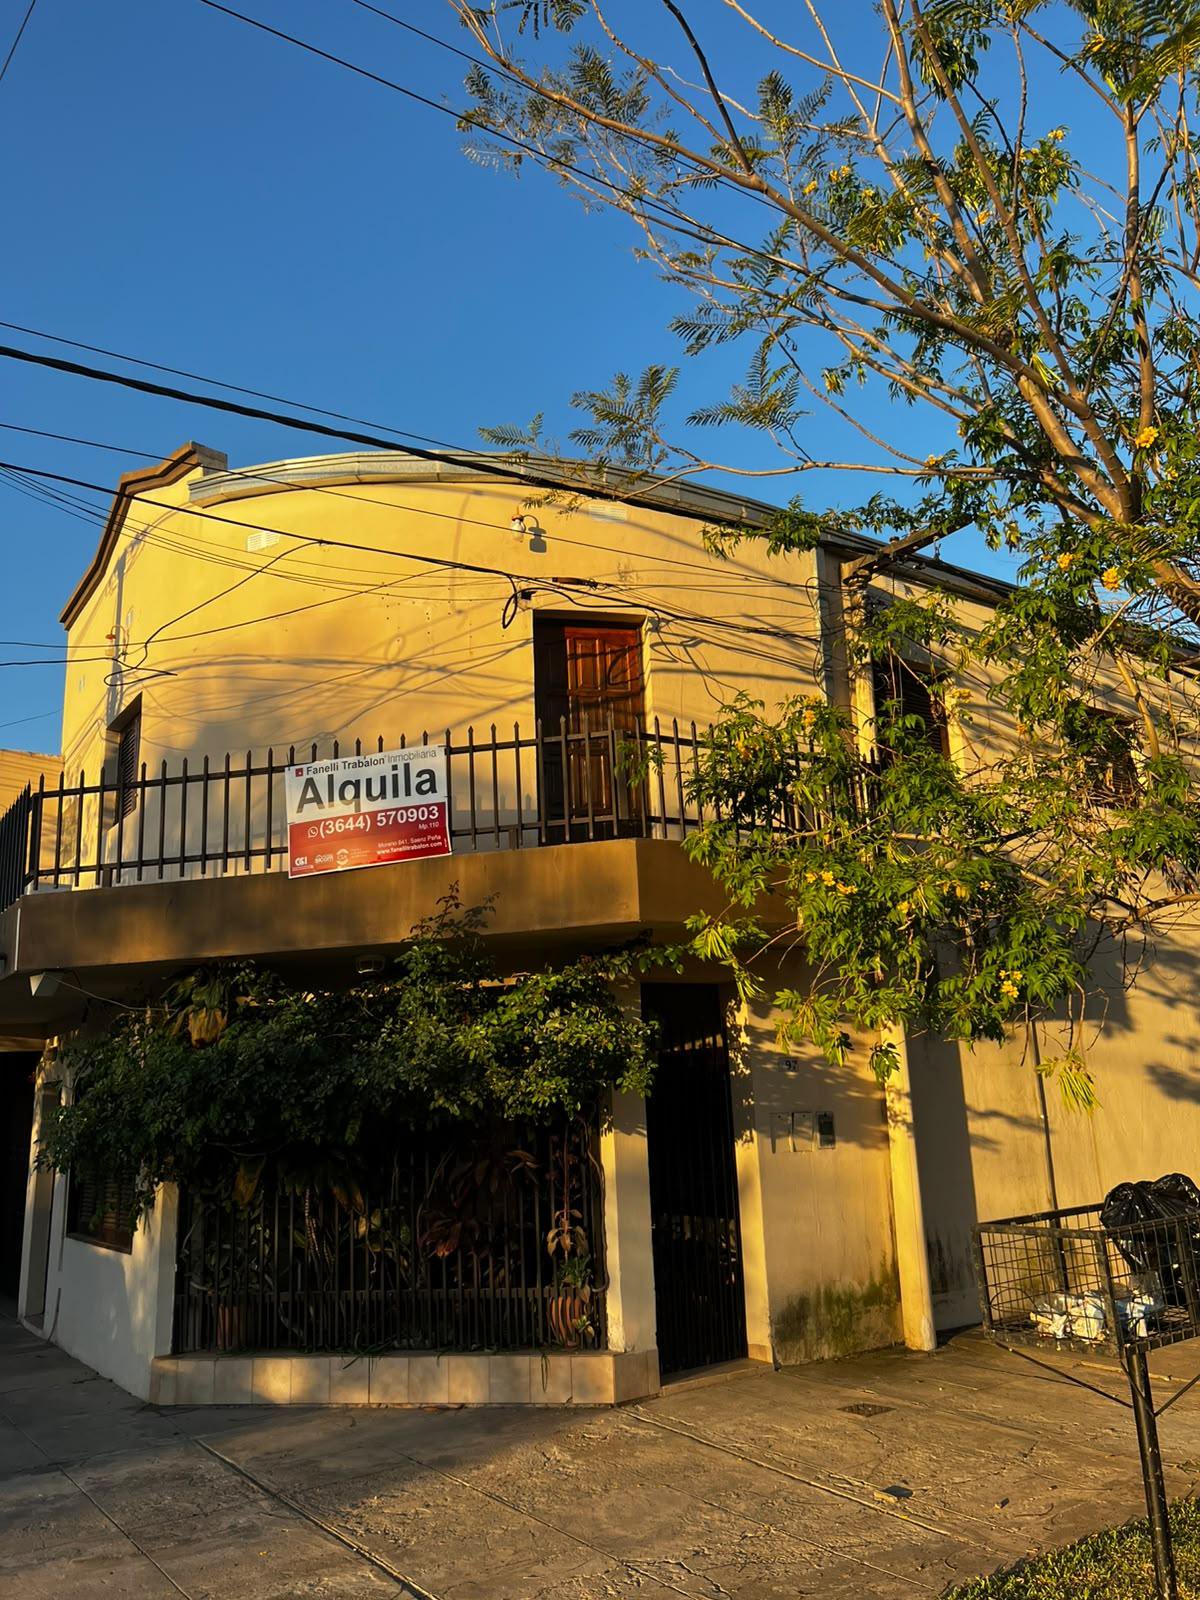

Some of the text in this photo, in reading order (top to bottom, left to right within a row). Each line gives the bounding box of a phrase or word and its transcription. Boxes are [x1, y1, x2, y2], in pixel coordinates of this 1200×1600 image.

[306, 749, 436, 776] Fanelli Trabalon Inmobiliaria
[296, 763, 438, 814] Alquila
[319, 805, 439, 839] (3644) 570903
